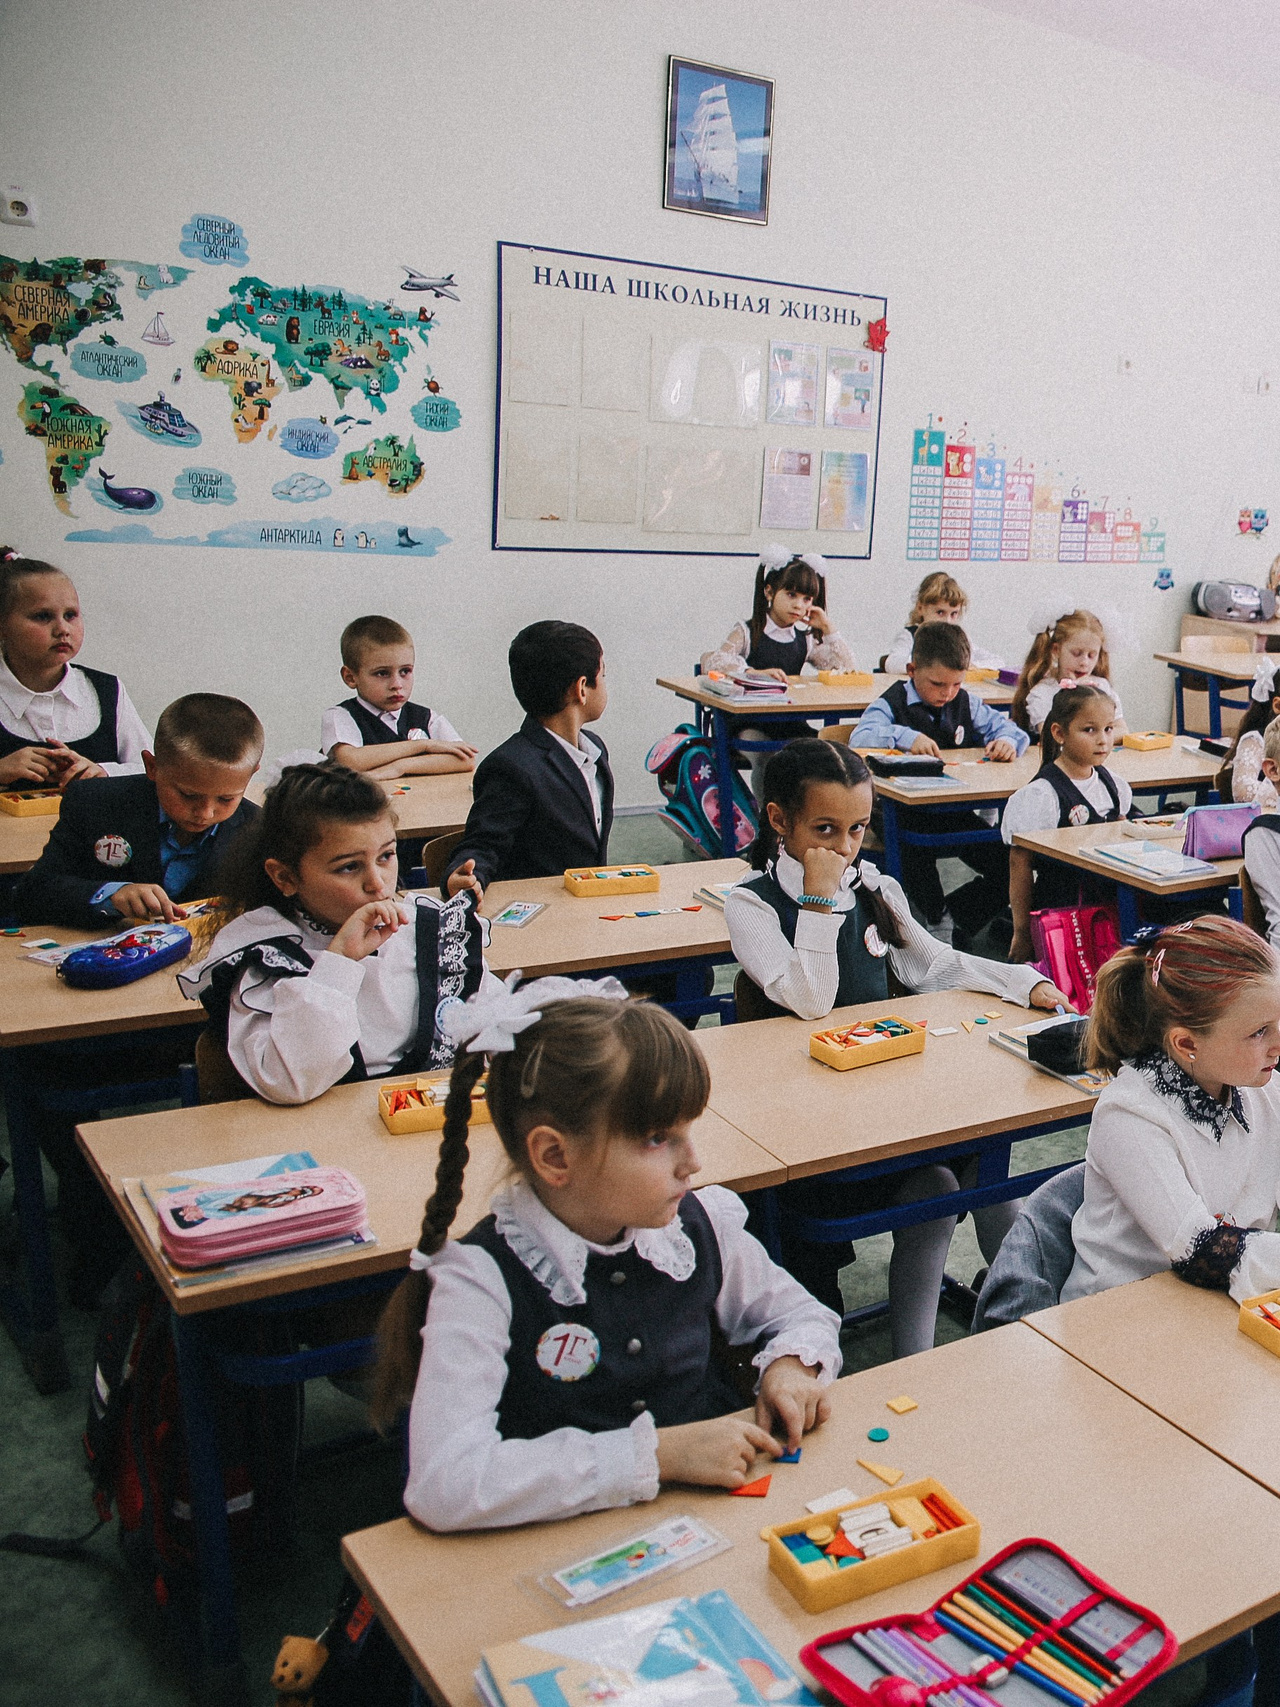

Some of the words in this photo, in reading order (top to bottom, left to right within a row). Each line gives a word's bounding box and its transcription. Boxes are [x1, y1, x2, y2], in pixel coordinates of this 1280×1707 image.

[196, 217, 236, 236] СЕВЕРНЫЙ
[192, 230, 240, 249] ЛЕДОВИТЫЙ
[203, 244, 230, 260] ОКЕАН
[14, 284, 71, 308] СЕВЕРНАЯ
[532, 265, 617, 295] НАША
[627, 278, 770, 314] ШКОЛЬНАЯ
[779, 299, 861, 327] ЖИЗНЬ
[18, 303, 70, 323] АМЕРИКА
[313, 319, 350, 338] ЕВРАЗИЯ
[80, 350, 138, 368] АТЛАНТИЧЕСКИЙ
[97, 364, 123, 378] ОКЕАН
[216, 359, 259, 379] АФРИКА
[424, 401, 449, 415] ТИХИЙ
[46, 417, 92, 434] ЮЖНАЯ
[424, 416, 448, 428] ОКЕАН
[927, 412, 933, 430] 1
[47, 434, 94, 450] АМЕРИКА
[287, 428, 329, 443] ИНДИЙСКИЙ
[956, 428, 967, 445] 2
[296, 441, 319, 453] ОКЕАН
[986, 441, 996, 458] 3
[363, 455, 408, 472] АВСТРАЛИЯ
[1013, 456, 1024, 472] 4
[188, 472, 222, 486] ЮЖНЫЙ
[192, 484, 219, 499] ОКЕАН
[1071, 484, 1080, 498] 6
[1101, 495, 1109, 511] 7
[1123, 507, 1132, 521] 8
[1150, 517, 1159, 532] 9
[260, 527, 322, 545] АНТАРКТИДА
[103, 842, 121, 860] 1Г
[552, 1332, 588, 1367] 1Г
